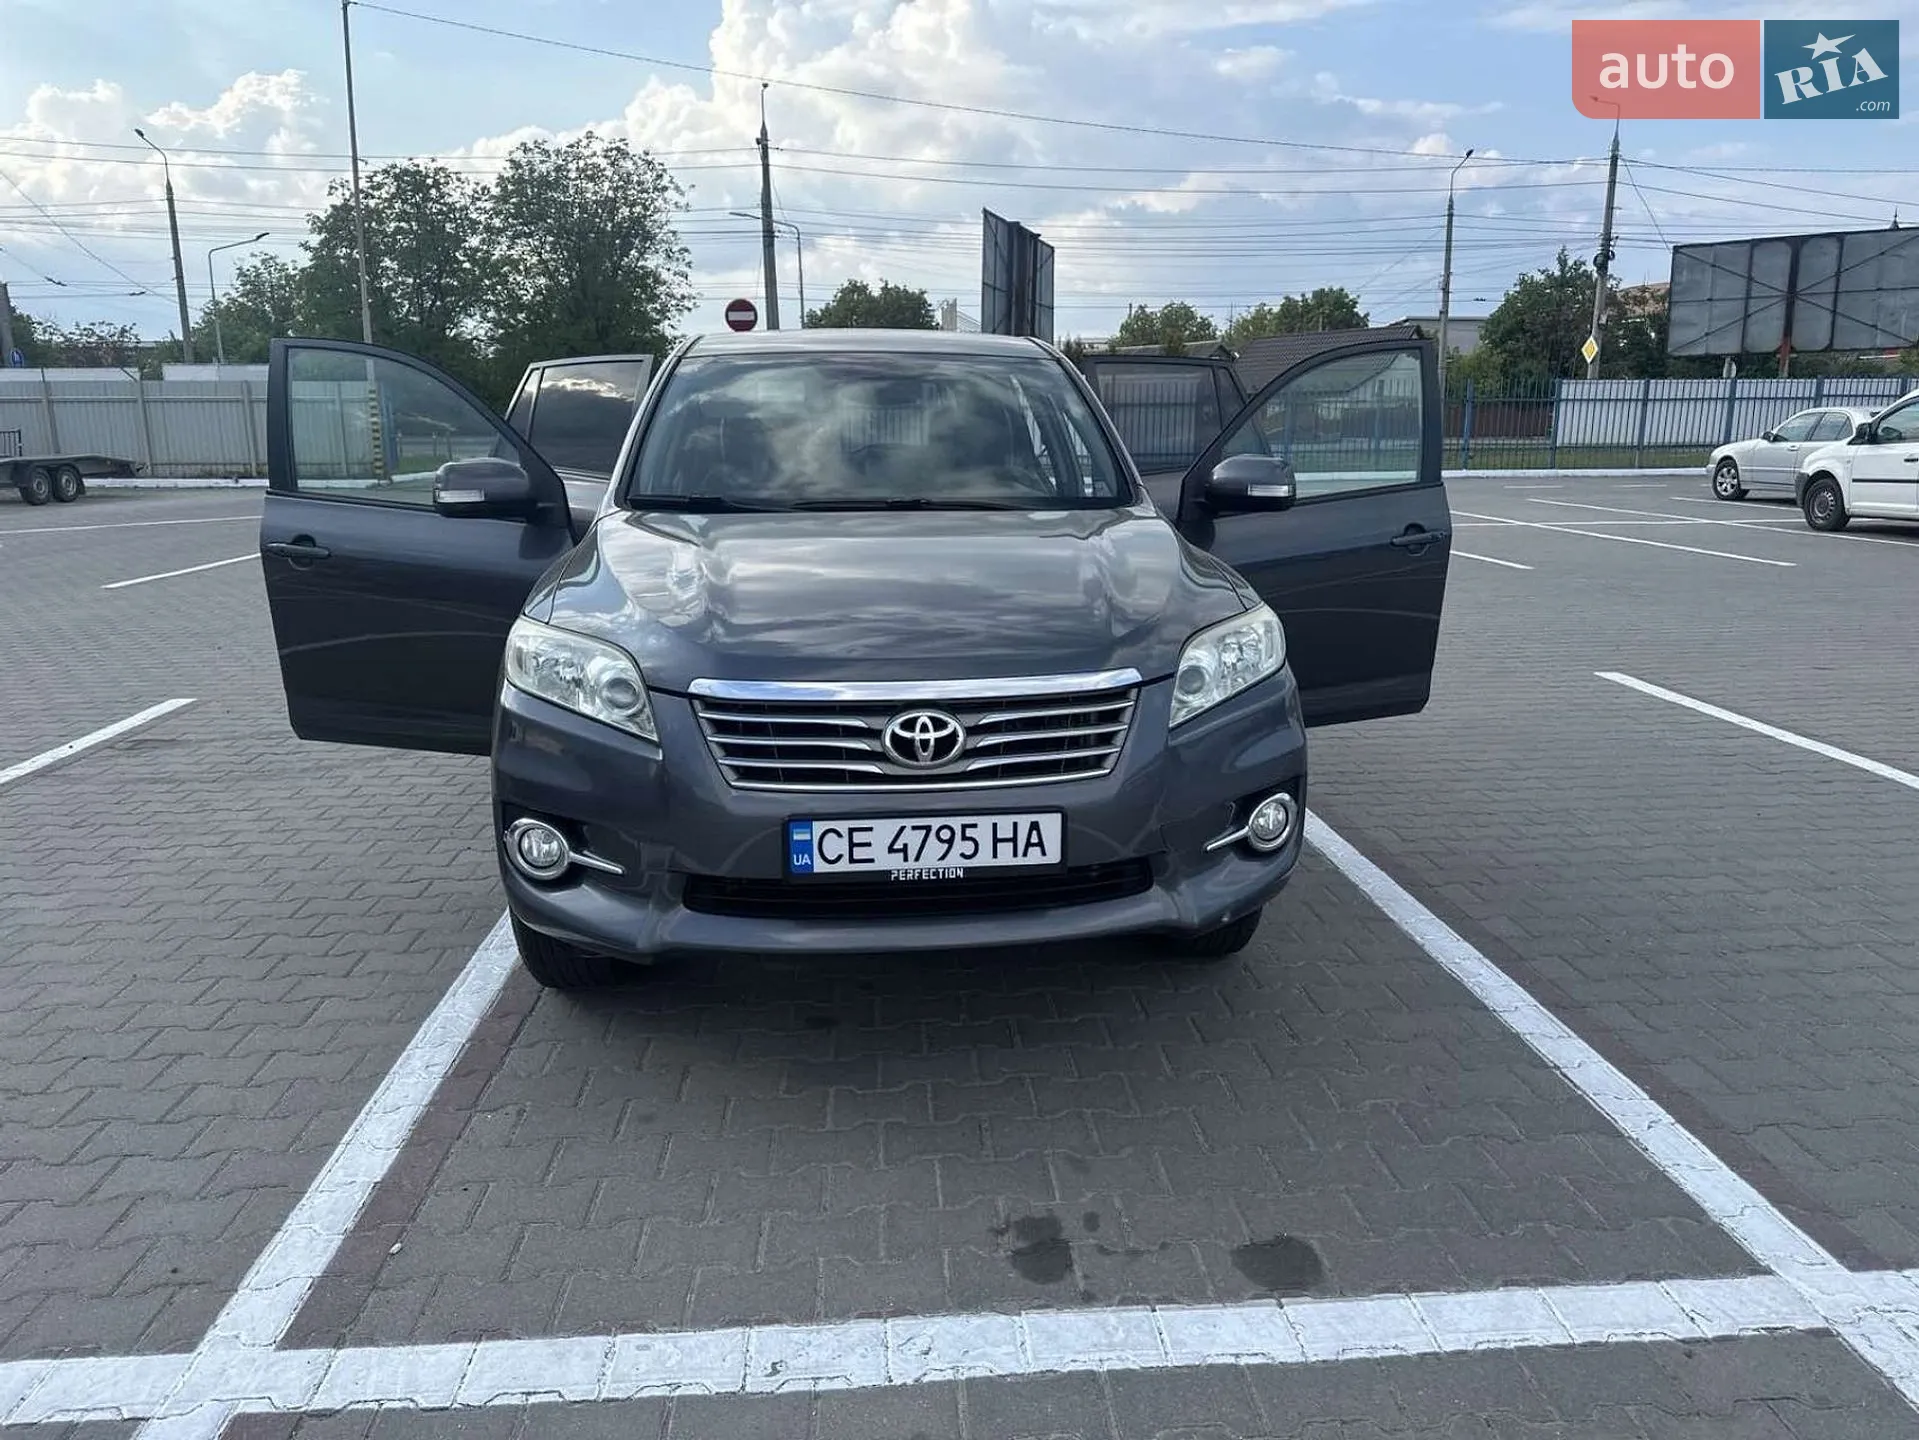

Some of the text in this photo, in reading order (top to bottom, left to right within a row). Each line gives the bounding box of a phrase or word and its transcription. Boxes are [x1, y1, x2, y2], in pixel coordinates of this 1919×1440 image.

[817, 820, 1048, 865] CE 4795 HA
[793, 854, 811, 866] UA
[890, 867, 964, 882] PERFECTION
